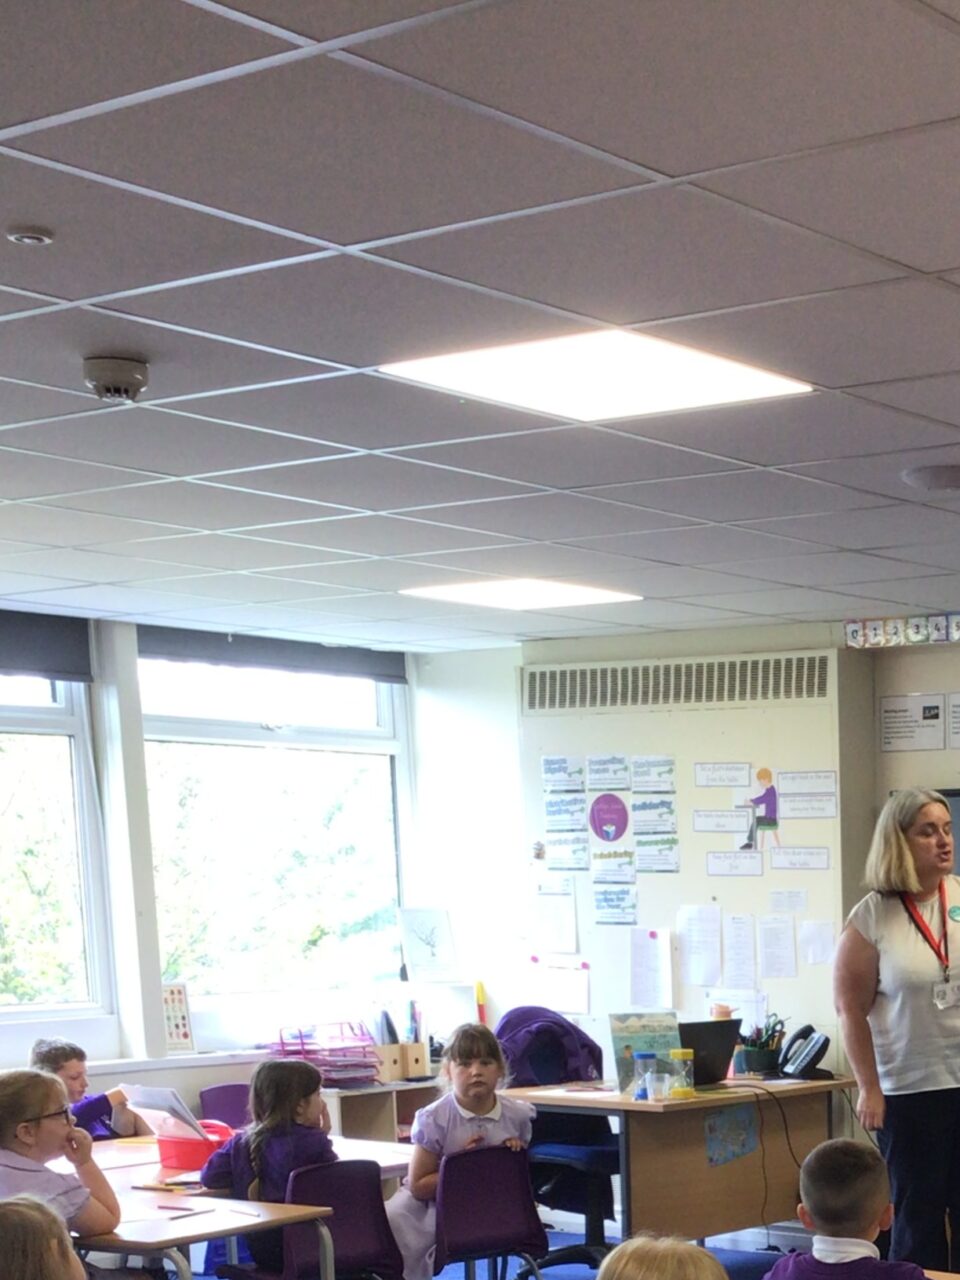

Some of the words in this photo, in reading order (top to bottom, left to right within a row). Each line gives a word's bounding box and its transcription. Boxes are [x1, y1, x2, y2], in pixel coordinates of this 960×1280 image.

[872, 627, 878, 636] 1
[892, 626, 898, 636] 2
[913, 624, 920, 634] 3
[934, 622, 942, 632] 4
